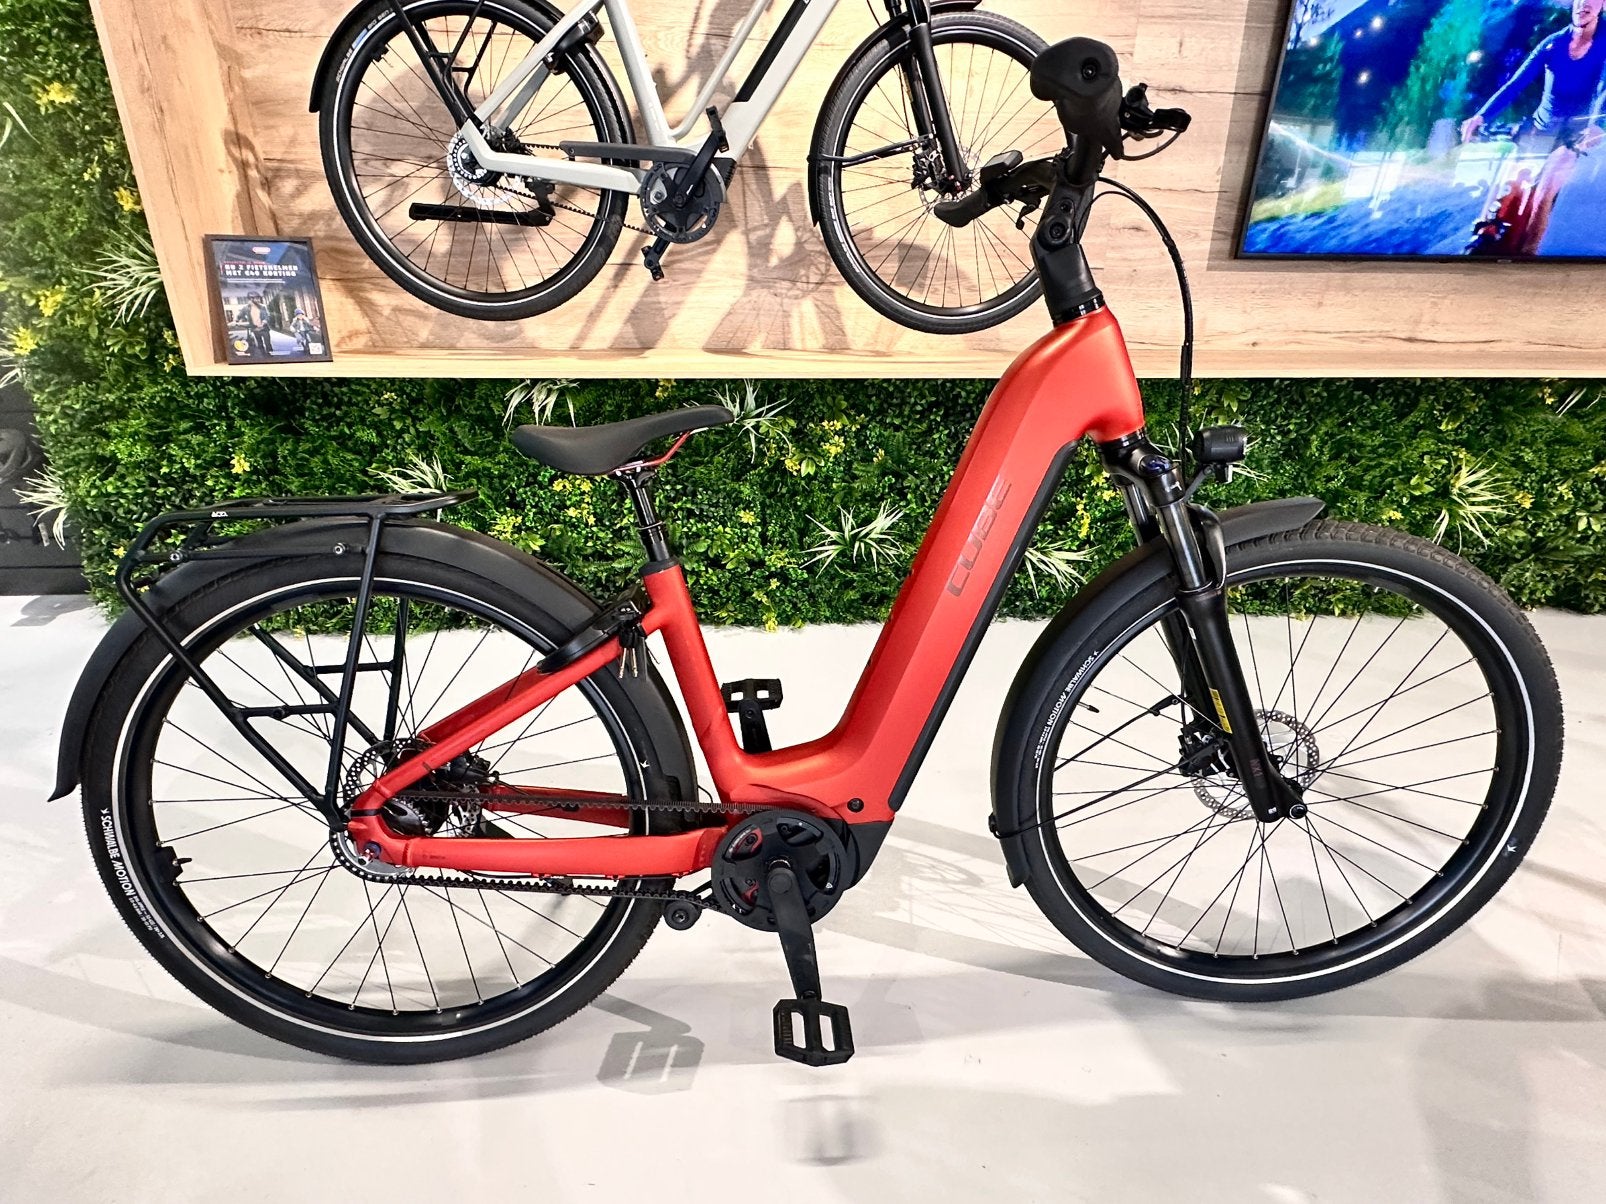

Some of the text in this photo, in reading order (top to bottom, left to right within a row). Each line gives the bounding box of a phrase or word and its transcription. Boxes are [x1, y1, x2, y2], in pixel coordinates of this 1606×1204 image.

[947, 476, 1012, 597] CUBE
[1046, 655, 1095, 726] SCHWALBE MOTION
[100, 814, 136, 897] SCHWALBE MOTION
